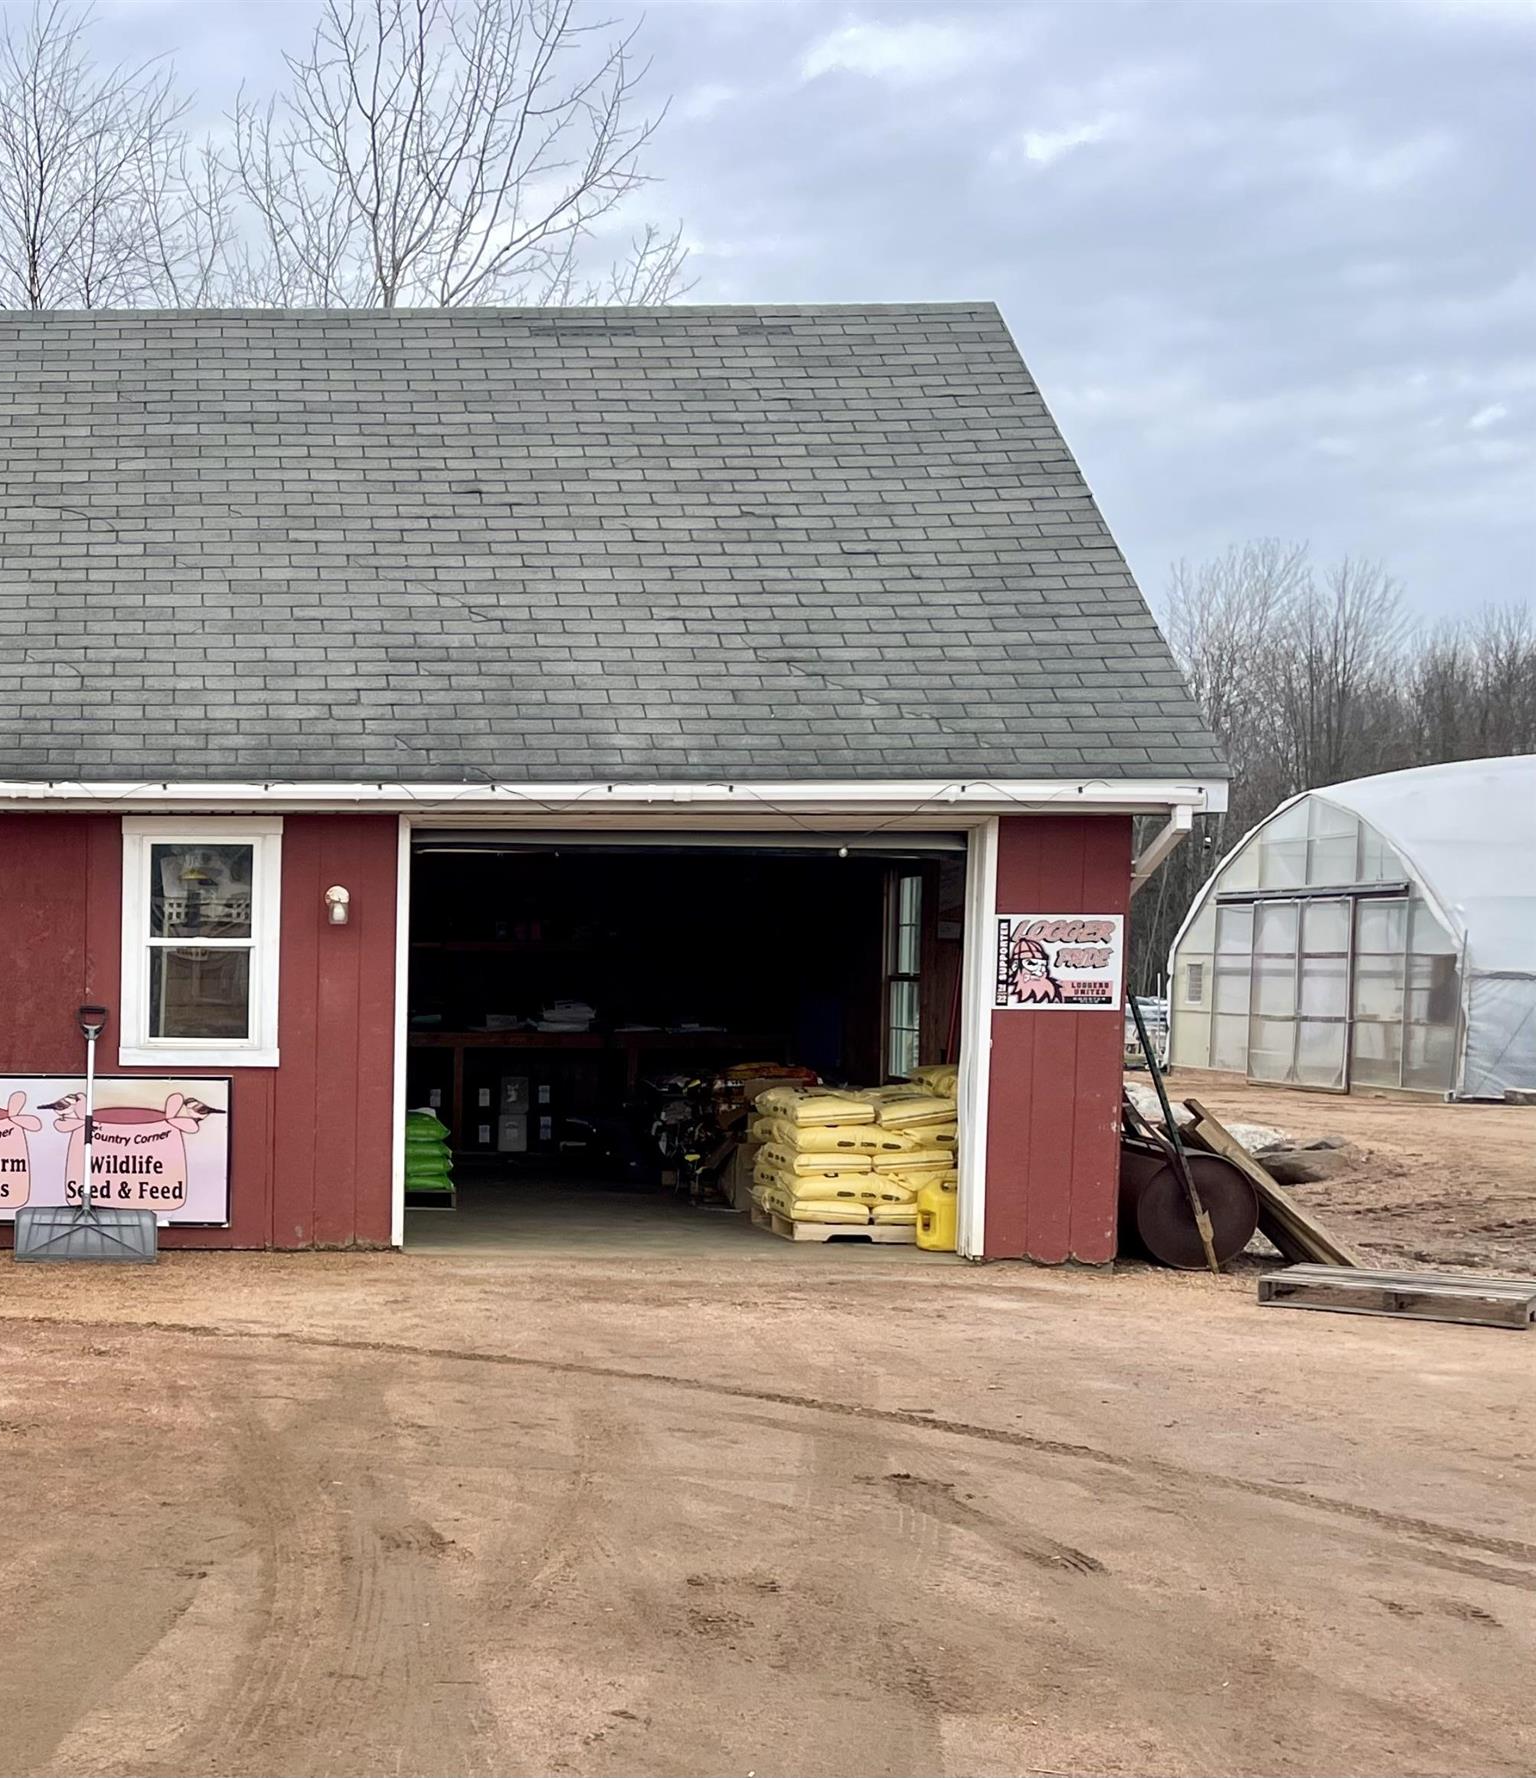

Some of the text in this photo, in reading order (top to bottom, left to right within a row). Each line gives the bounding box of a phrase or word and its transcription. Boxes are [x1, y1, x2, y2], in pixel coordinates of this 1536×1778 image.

[998, 922, 1009, 981] SUPPORTER
[134, 1130, 172, 1145] Corner
[90, 1155, 164, 1174] Wildlife
[118, 1181, 132, 1199] &
[138, 1180, 184, 1200] Feed
